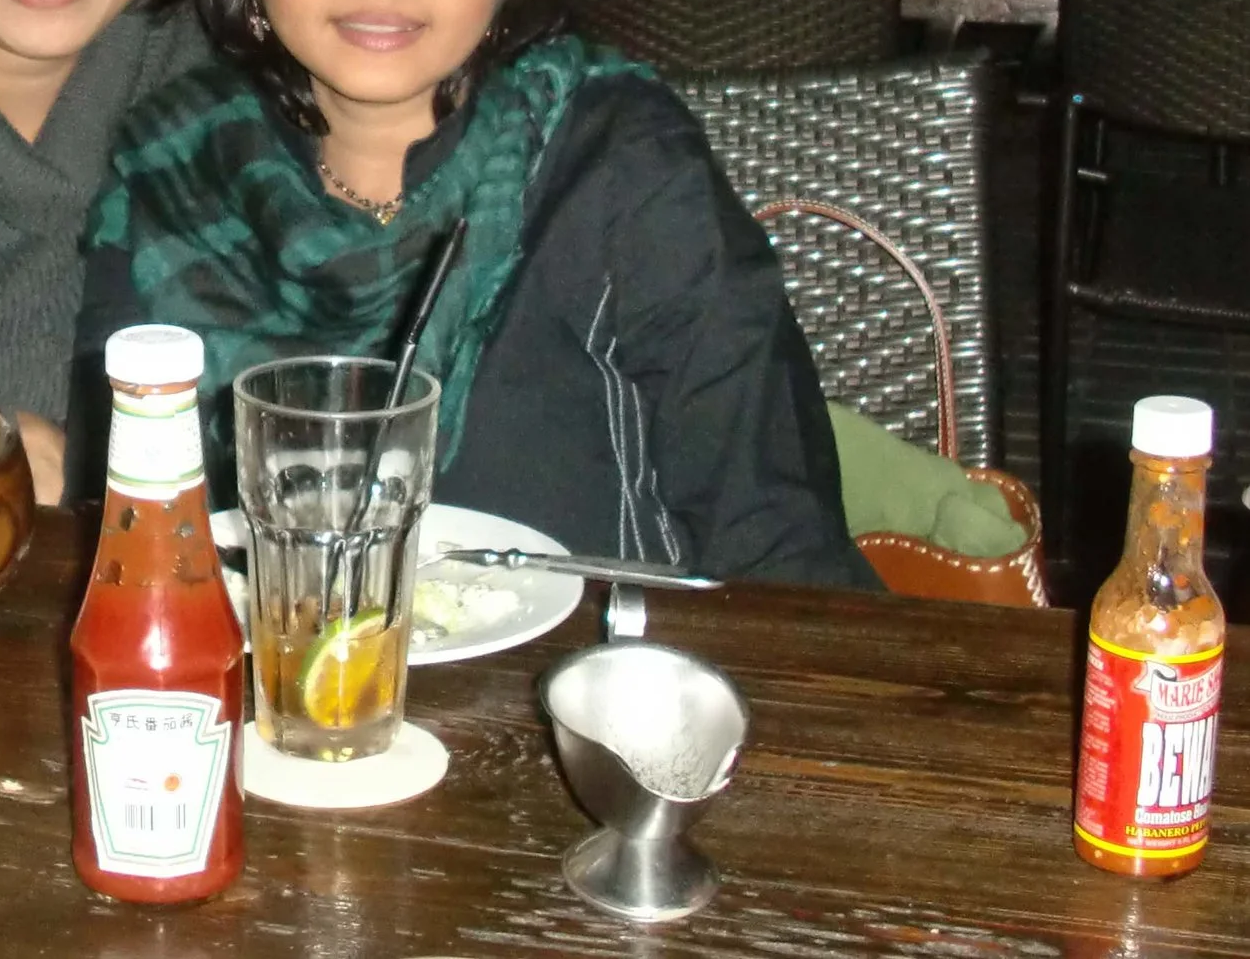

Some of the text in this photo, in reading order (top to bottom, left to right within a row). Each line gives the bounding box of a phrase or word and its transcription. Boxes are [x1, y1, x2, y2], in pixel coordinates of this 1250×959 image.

[1157, 678, 1204, 707] MARIE
[1136, 714, 1217, 808] BEWA
[1125, 825, 1190, 839] HABANERO
